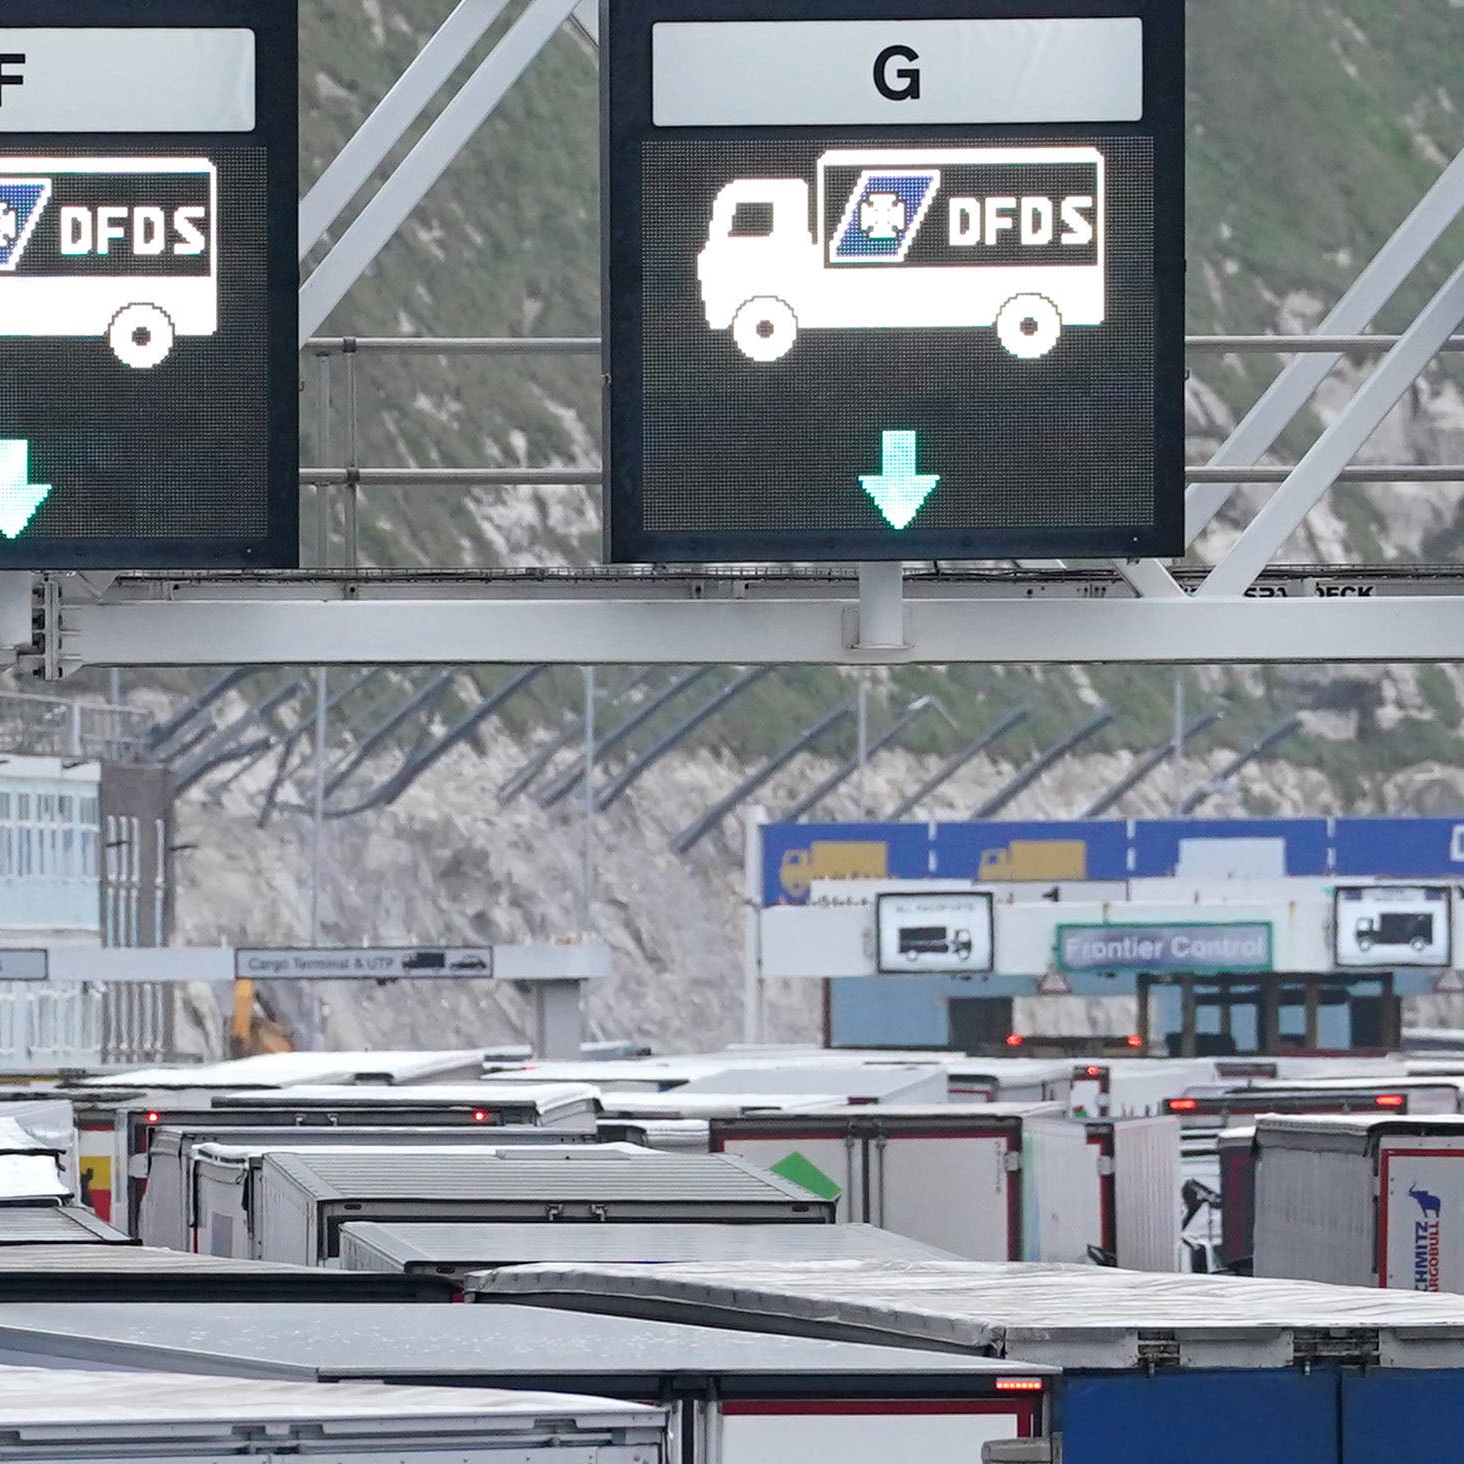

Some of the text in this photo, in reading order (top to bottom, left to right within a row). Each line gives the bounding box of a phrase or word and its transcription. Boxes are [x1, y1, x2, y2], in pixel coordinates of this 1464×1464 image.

[873, 45, 921, 101] G
[60, 206, 206, 255] DFDS
[949, 195, 1093, 247] DFDS
[1066, 935, 1267, 961] Frontier Control
[1414, 1221, 1428, 1292] CHMITZ
